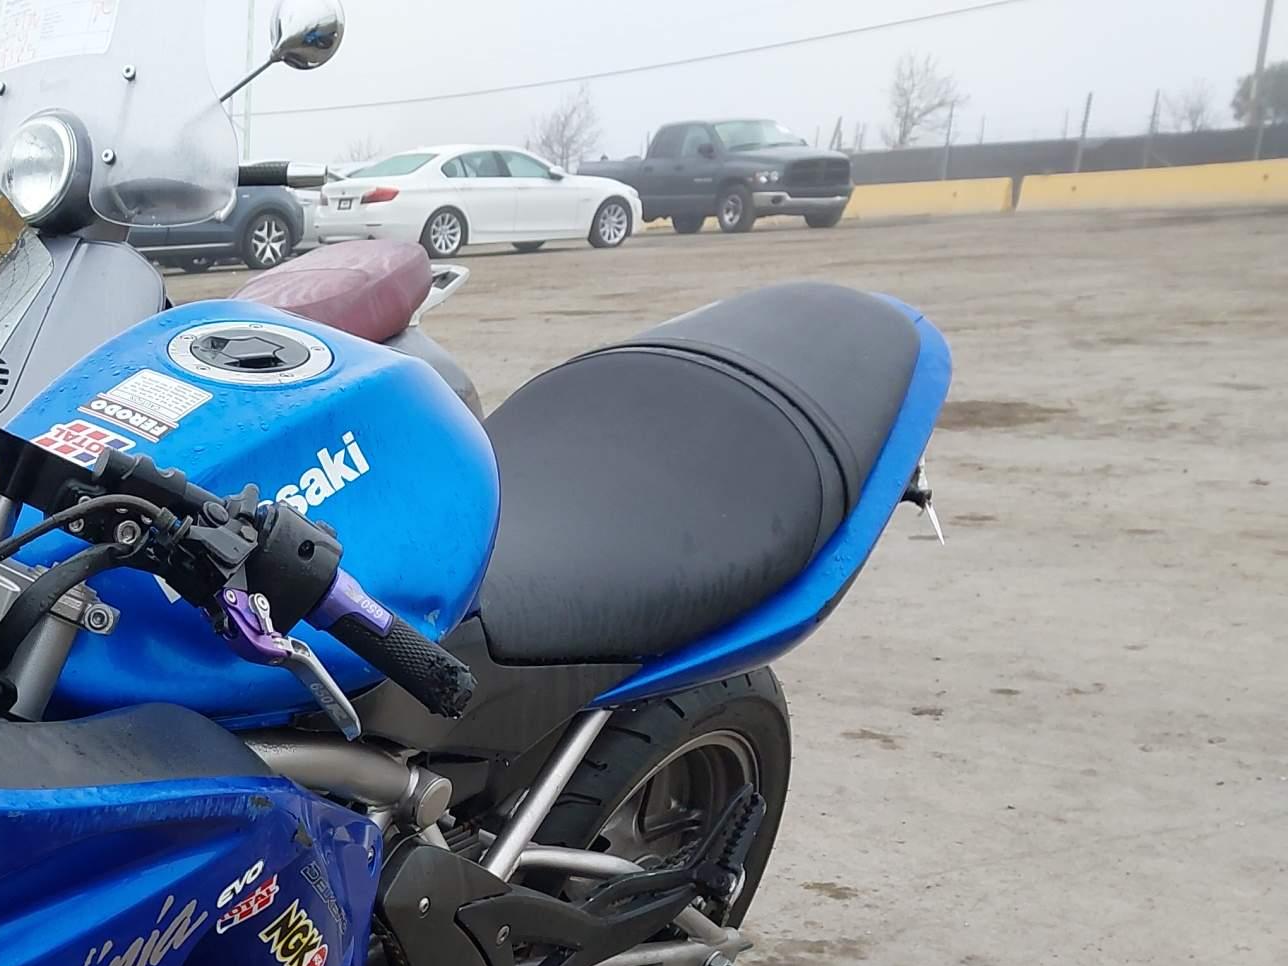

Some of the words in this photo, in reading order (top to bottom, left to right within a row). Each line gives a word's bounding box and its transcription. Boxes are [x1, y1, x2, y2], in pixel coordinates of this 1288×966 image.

[90, 399, 169, 437] FERODO
[53, 426, 106, 455] OTAL
[257, 430, 370, 516] saki
[216, 859, 265, 909] EVO
